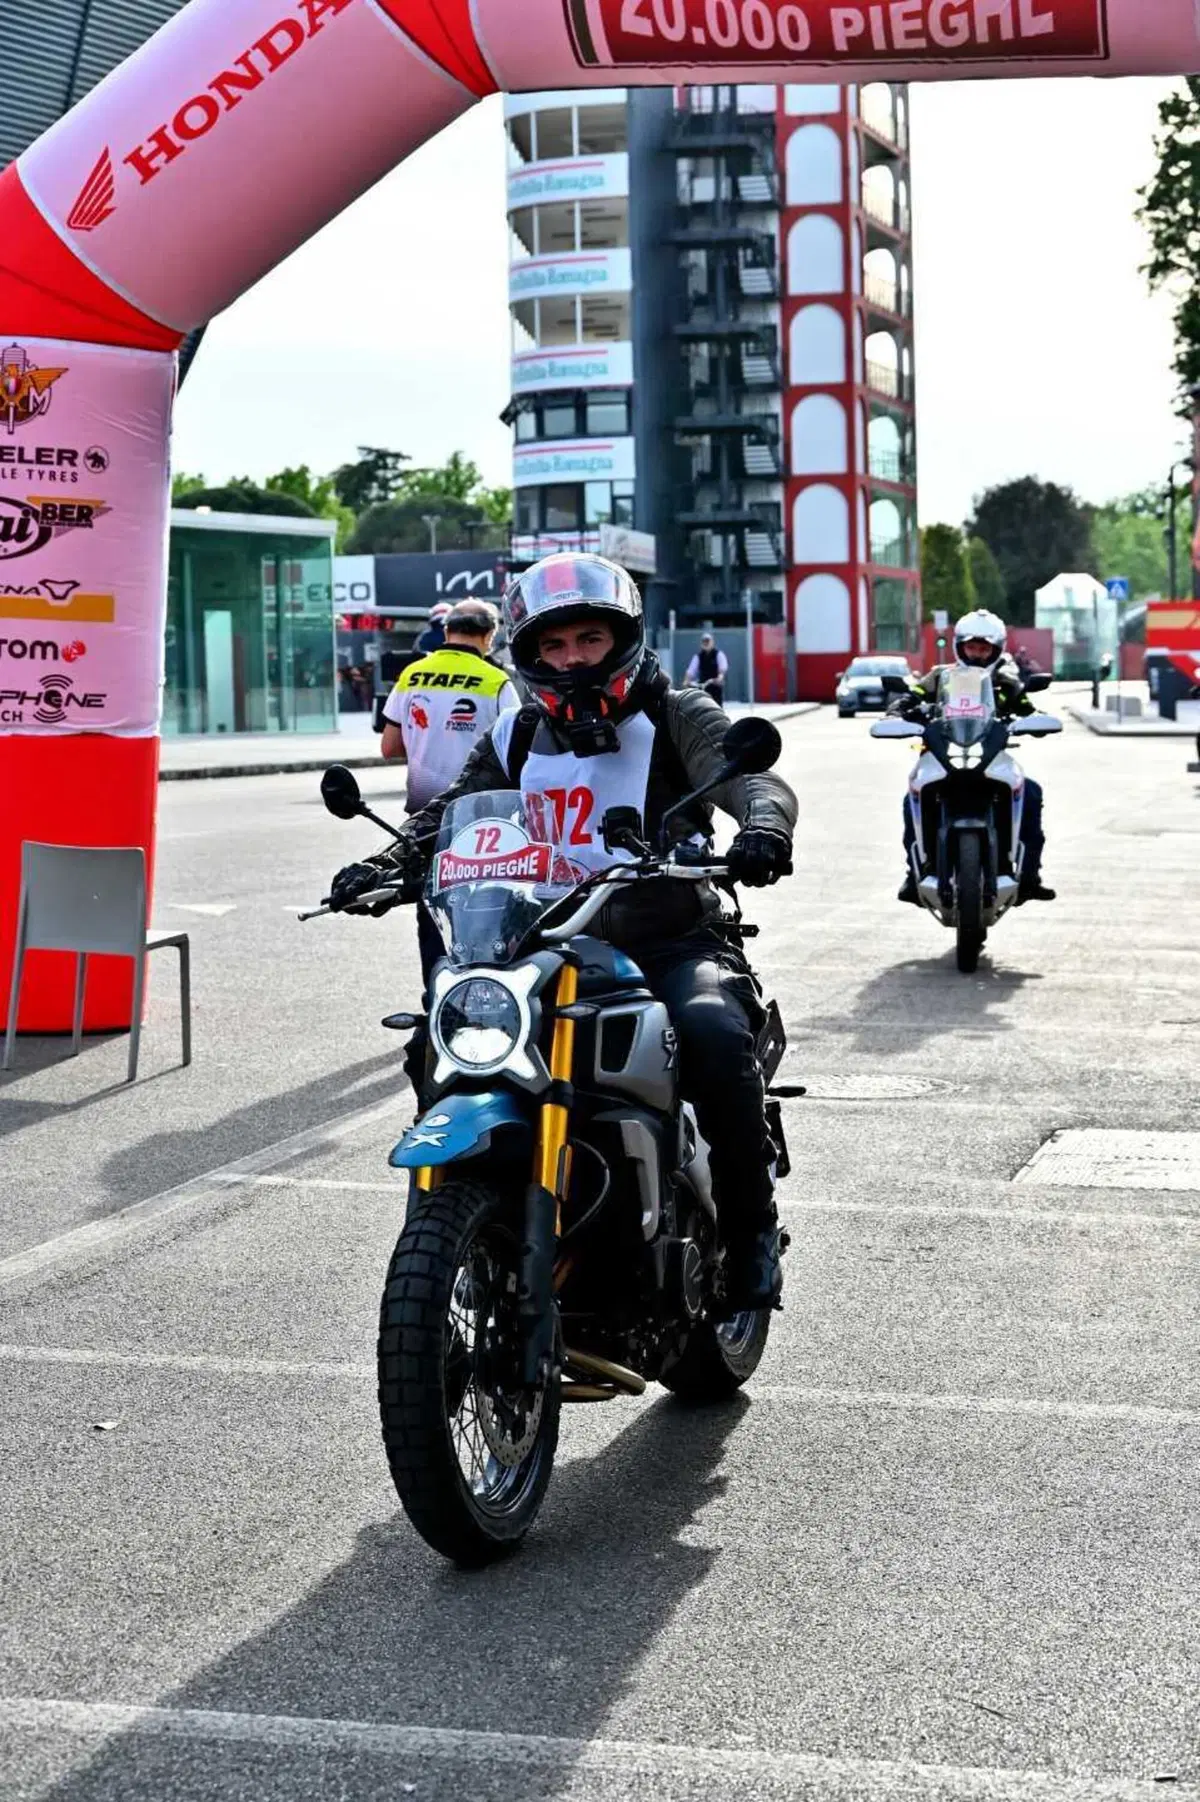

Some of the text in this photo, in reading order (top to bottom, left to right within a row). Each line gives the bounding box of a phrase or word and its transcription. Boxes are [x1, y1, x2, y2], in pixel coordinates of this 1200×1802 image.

[122, 0, 351, 186] HONDA
[0, 445, 79, 467] ELER
[27, 469, 79, 482] TYRES
[41, 503, 93, 521] BER
[408, 672, 483, 689] STAFF
[1, 710, 22, 722] CH
[541, 785, 594, 846] 72
[475, 827, 501, 854] 72
[441, 858, 479, 880] 20.000
[483, 851, 540, 877] PIEGHE
